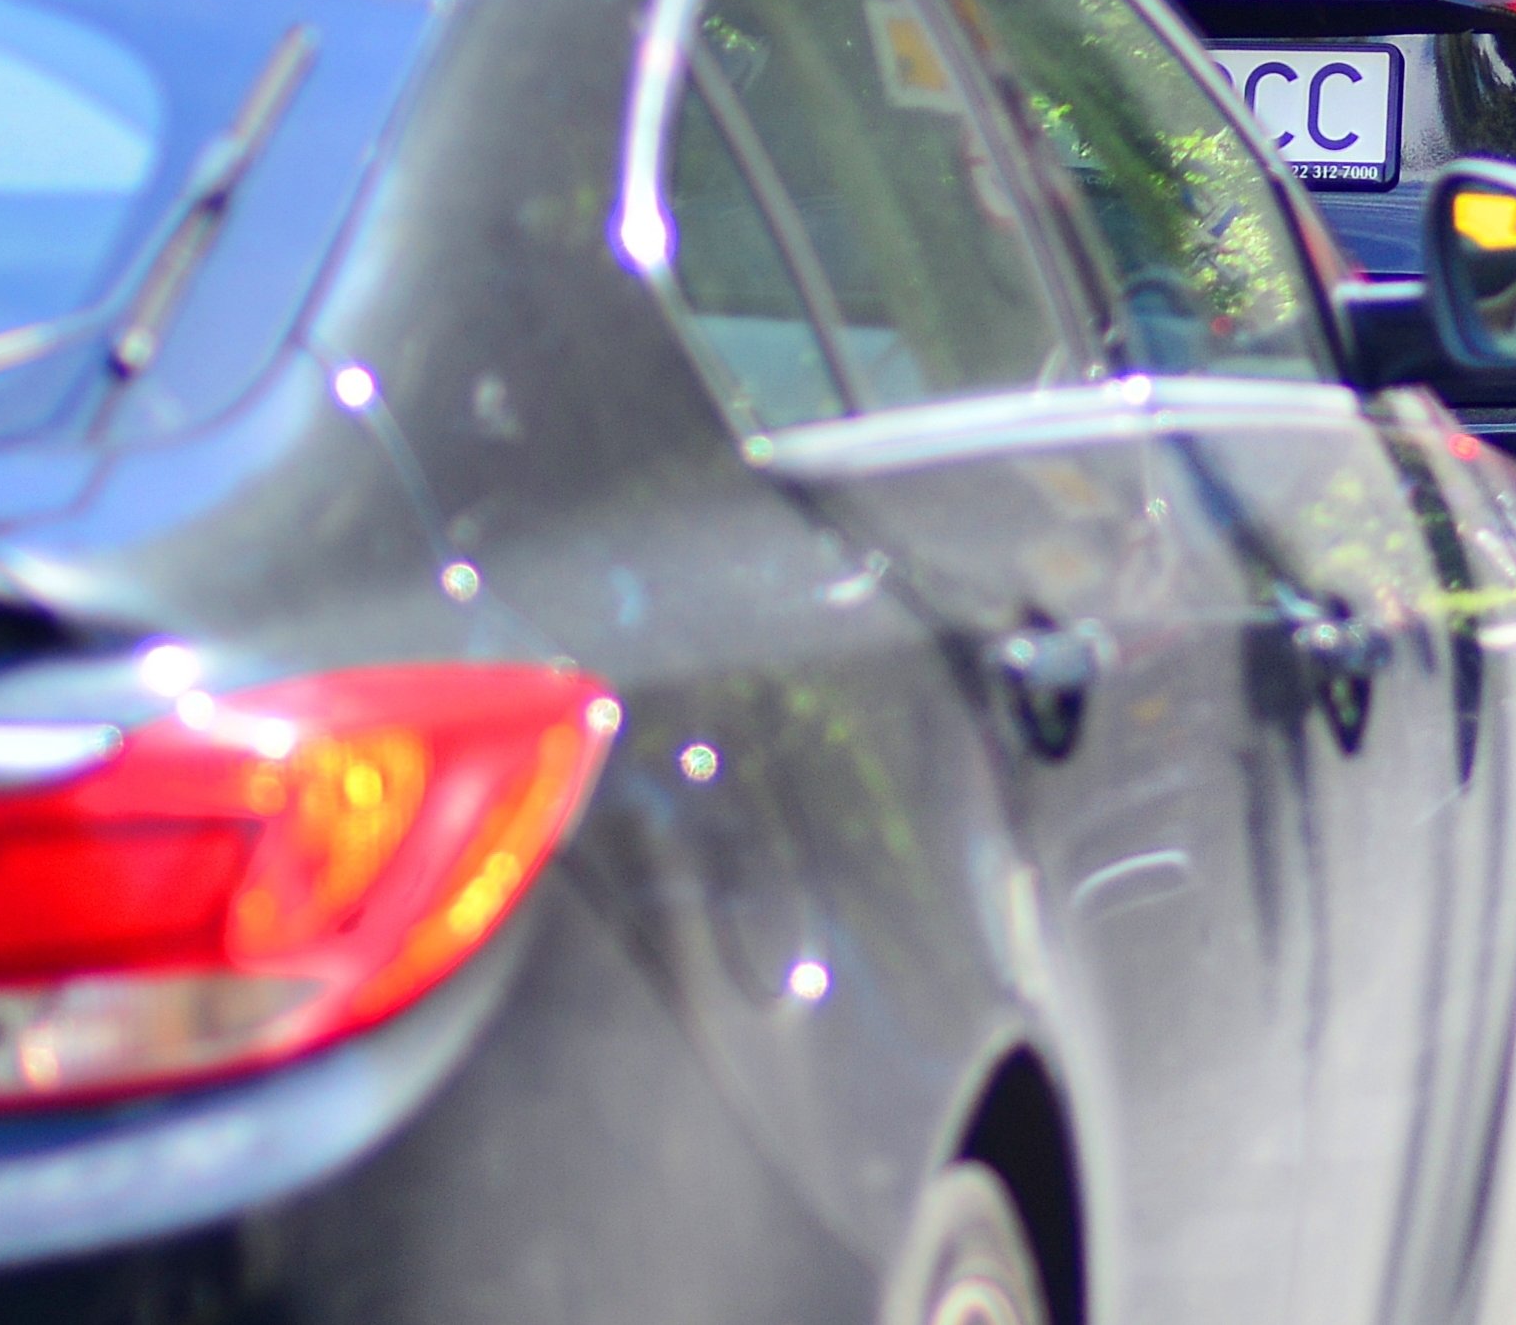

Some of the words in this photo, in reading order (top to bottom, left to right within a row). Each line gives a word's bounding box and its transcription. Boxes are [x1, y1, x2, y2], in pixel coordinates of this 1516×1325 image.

[1213, 61, 1363, 151] CC
[1312, 165, 1338, 179] 312
[1342, 165, 1378, 180] 7000
